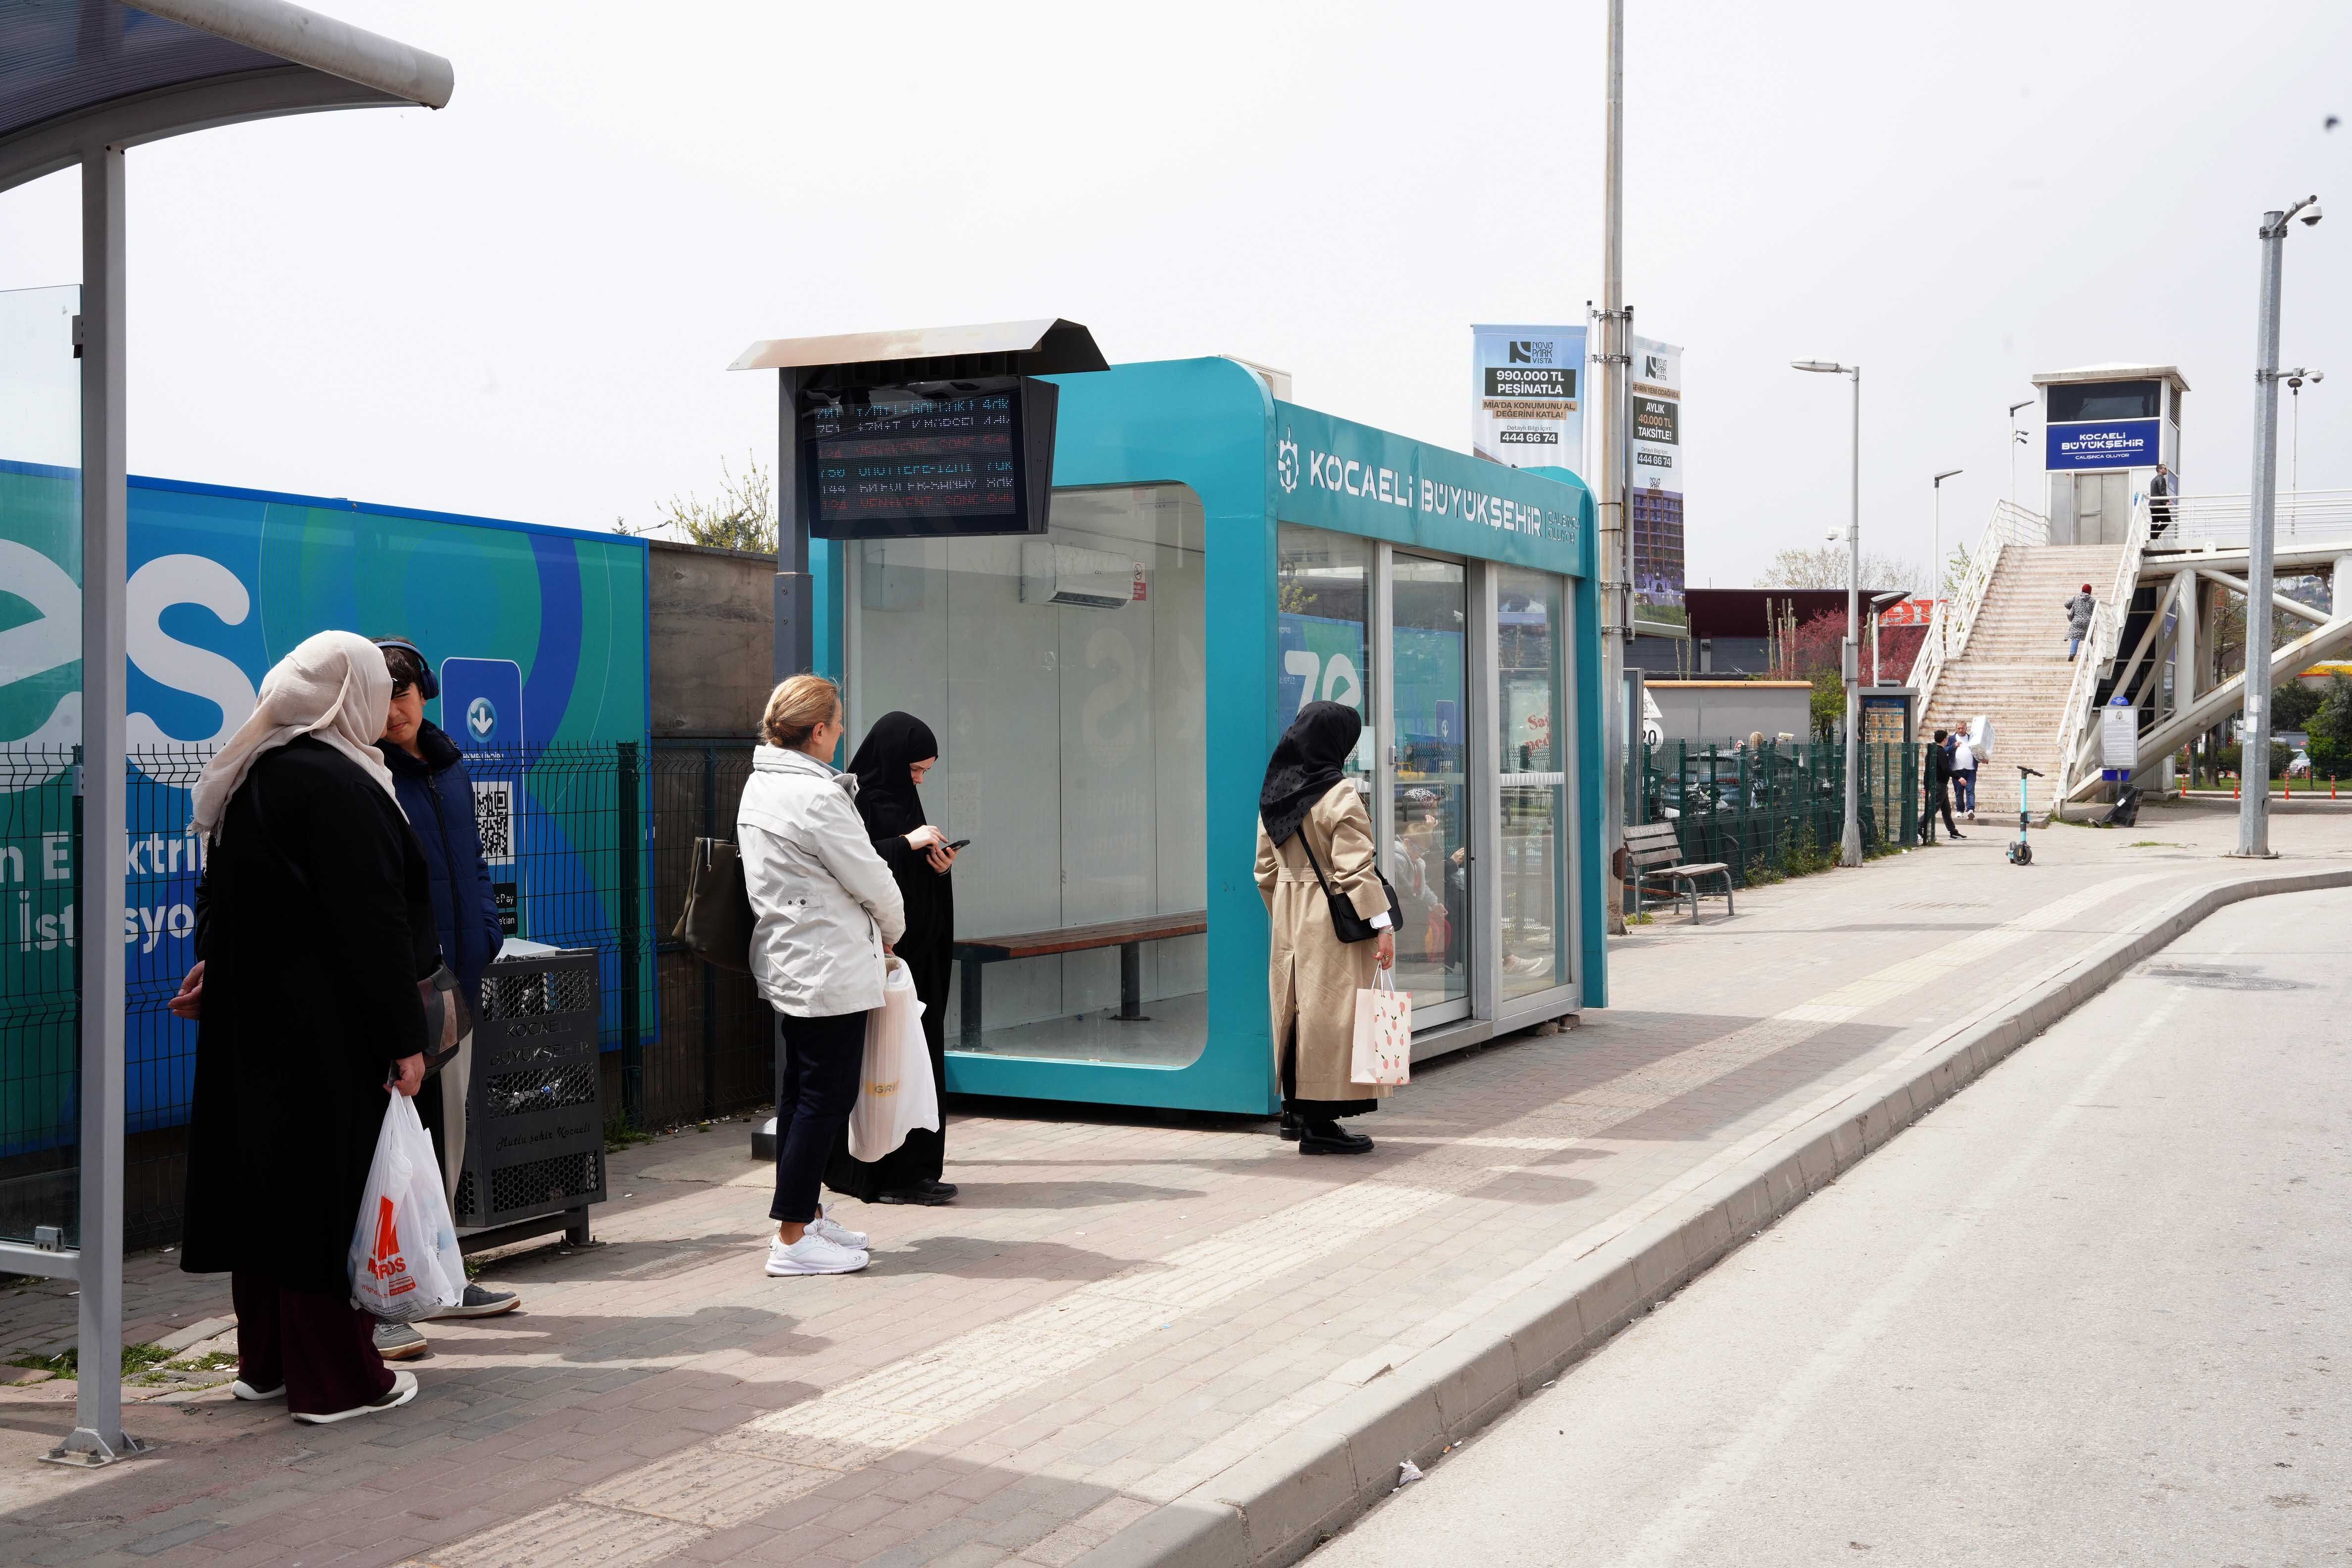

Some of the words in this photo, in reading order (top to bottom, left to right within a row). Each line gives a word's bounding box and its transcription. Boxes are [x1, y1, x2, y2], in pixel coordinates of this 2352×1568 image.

[1532, 349, 1553, 357] PARK
[1496, 370, 1548, 381] 990.000
[1550, 371, 1565, 382] TL
[1656, 366, 1667, 375] PARK
[1498, 381, 1563, 395] PEŞİNATLA
[1658, 389, 1679, 399] ODAĞINDA
[1496, 409, 1534, 418] DEĞERİNİ
[1646, 402, 1665, 414] AYLIK
[1638, 414, 1663, 426] 40.000
[1664, 417, 1671, 428] TL
[1502, 433, 1524, 441] 444
[1526, 434, 1541, 442] 66
[1543, 434, 1556, 442] 74
[1638, 426, 1671, 440] TAKSİTLE!
[2079, 432, 2126, 441] KOCAELİ
[2062, 439, 2144, 449] BÜYÜKŞEHİR
[1638, 455, 1652, 464] 444
[1653, 456, 1663, 465] 66
[1664, 457, 1671, 466] 74
[1310, 450, 1413, 508] KOCAELİ
[1421, 478, 1542, 538] BÜYÜKŞEHİR
[1548, 527, 1575, 544] OLUYOR
[506, 1016, 572, 1038] KOCAELİ
[490, 1039, 590, 1066] BÜYÜKŞEHİR
[496, 1135, 527, 1152] Mutlu
[557, 1123, 590, 1139] Kocaeli
